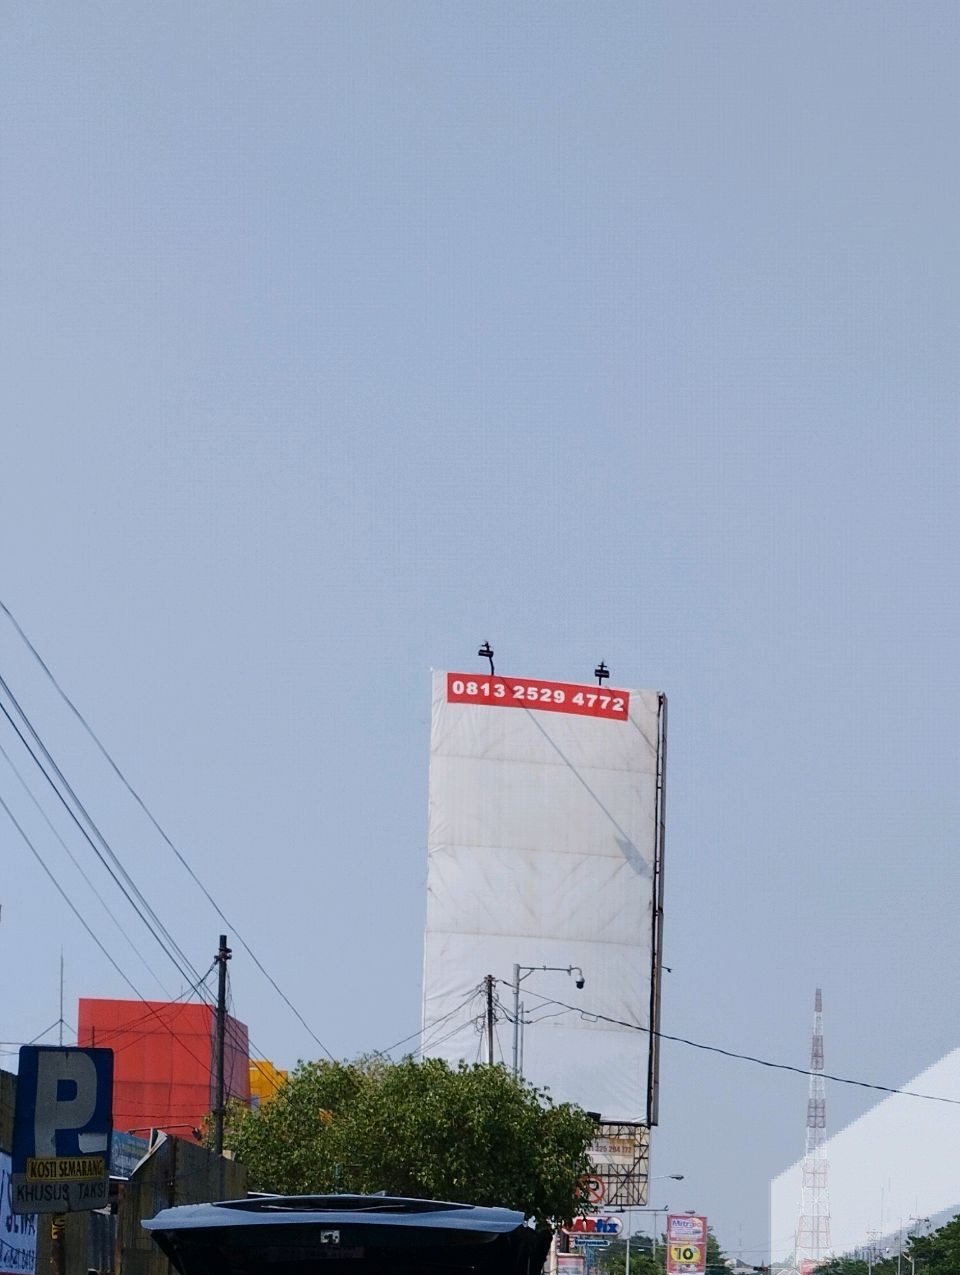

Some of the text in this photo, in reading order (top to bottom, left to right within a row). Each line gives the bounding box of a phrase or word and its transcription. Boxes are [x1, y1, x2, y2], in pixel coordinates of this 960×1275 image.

[452, 681, 625, 712] 0813 2529 4772
[35, 1051, 98, 1158] P
[30, 1161, 57, 1178] KOSTI
[59, 1160, 103, 1177] SEMARANG
[17, 1182, 106, 1202] KHUSUS TAKSI
